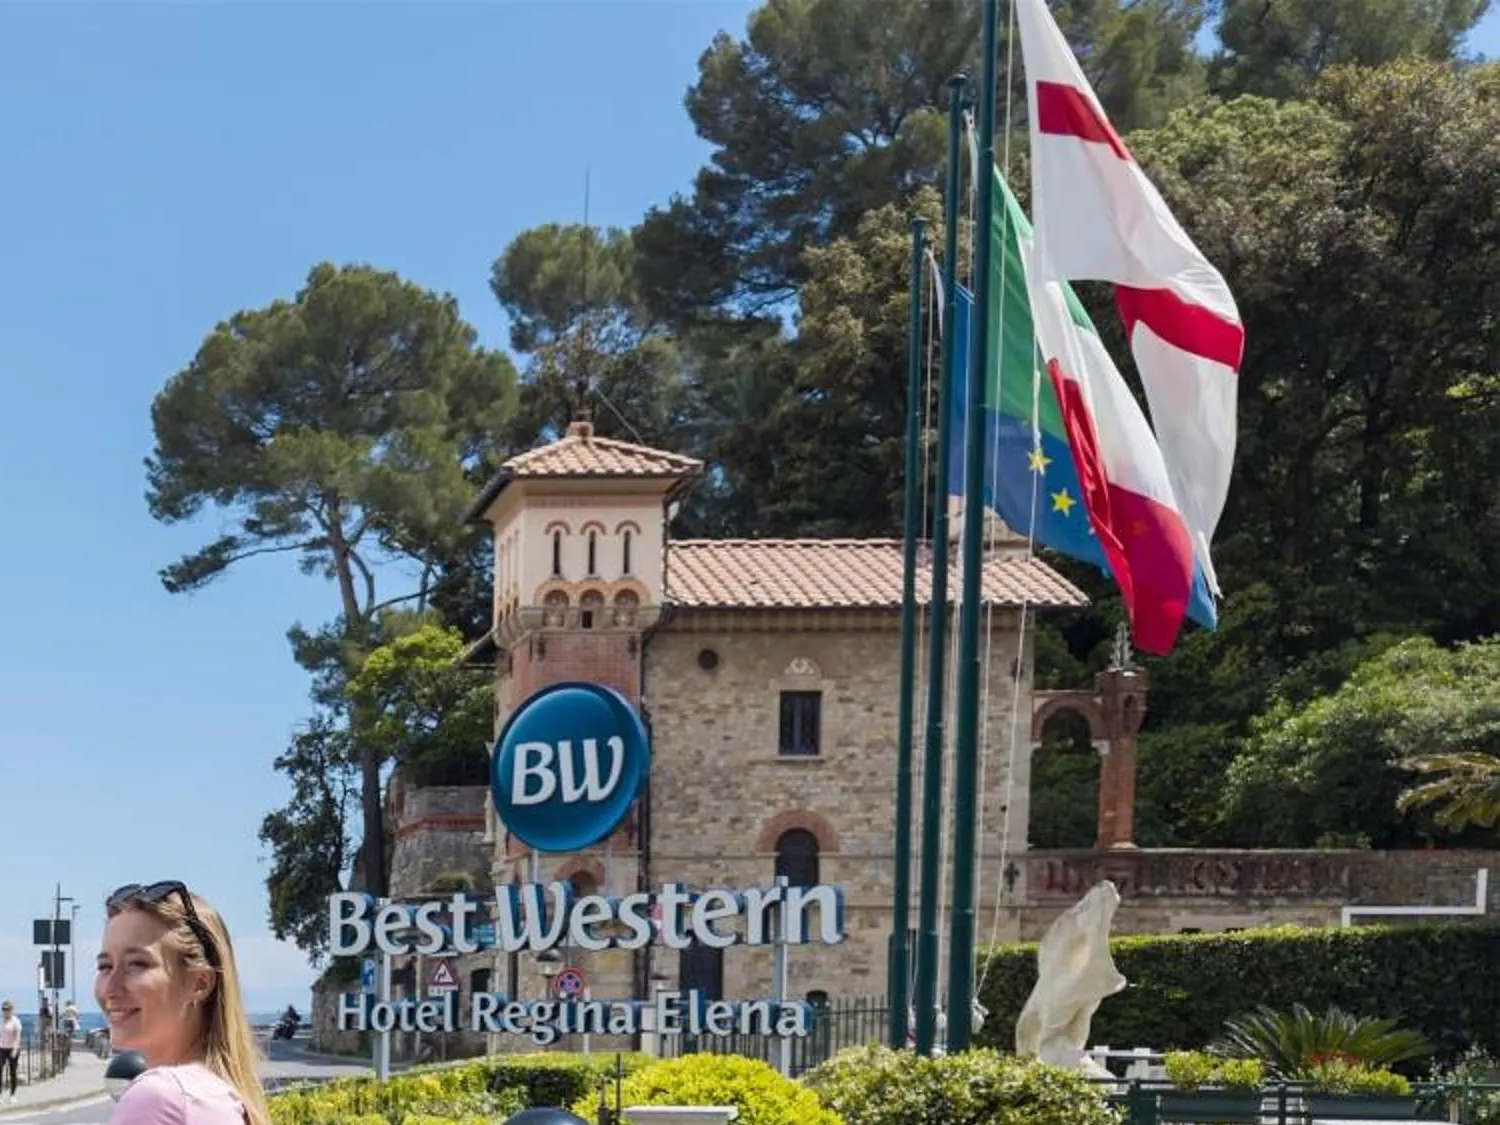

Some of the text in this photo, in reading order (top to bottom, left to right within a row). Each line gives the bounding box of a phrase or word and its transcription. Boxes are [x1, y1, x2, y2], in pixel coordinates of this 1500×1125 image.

[511, 736, 624, 805] BW
[327, 881, 847, 958] Best Western
[337, 990, 809, 1044] Hotel Regina Elena
